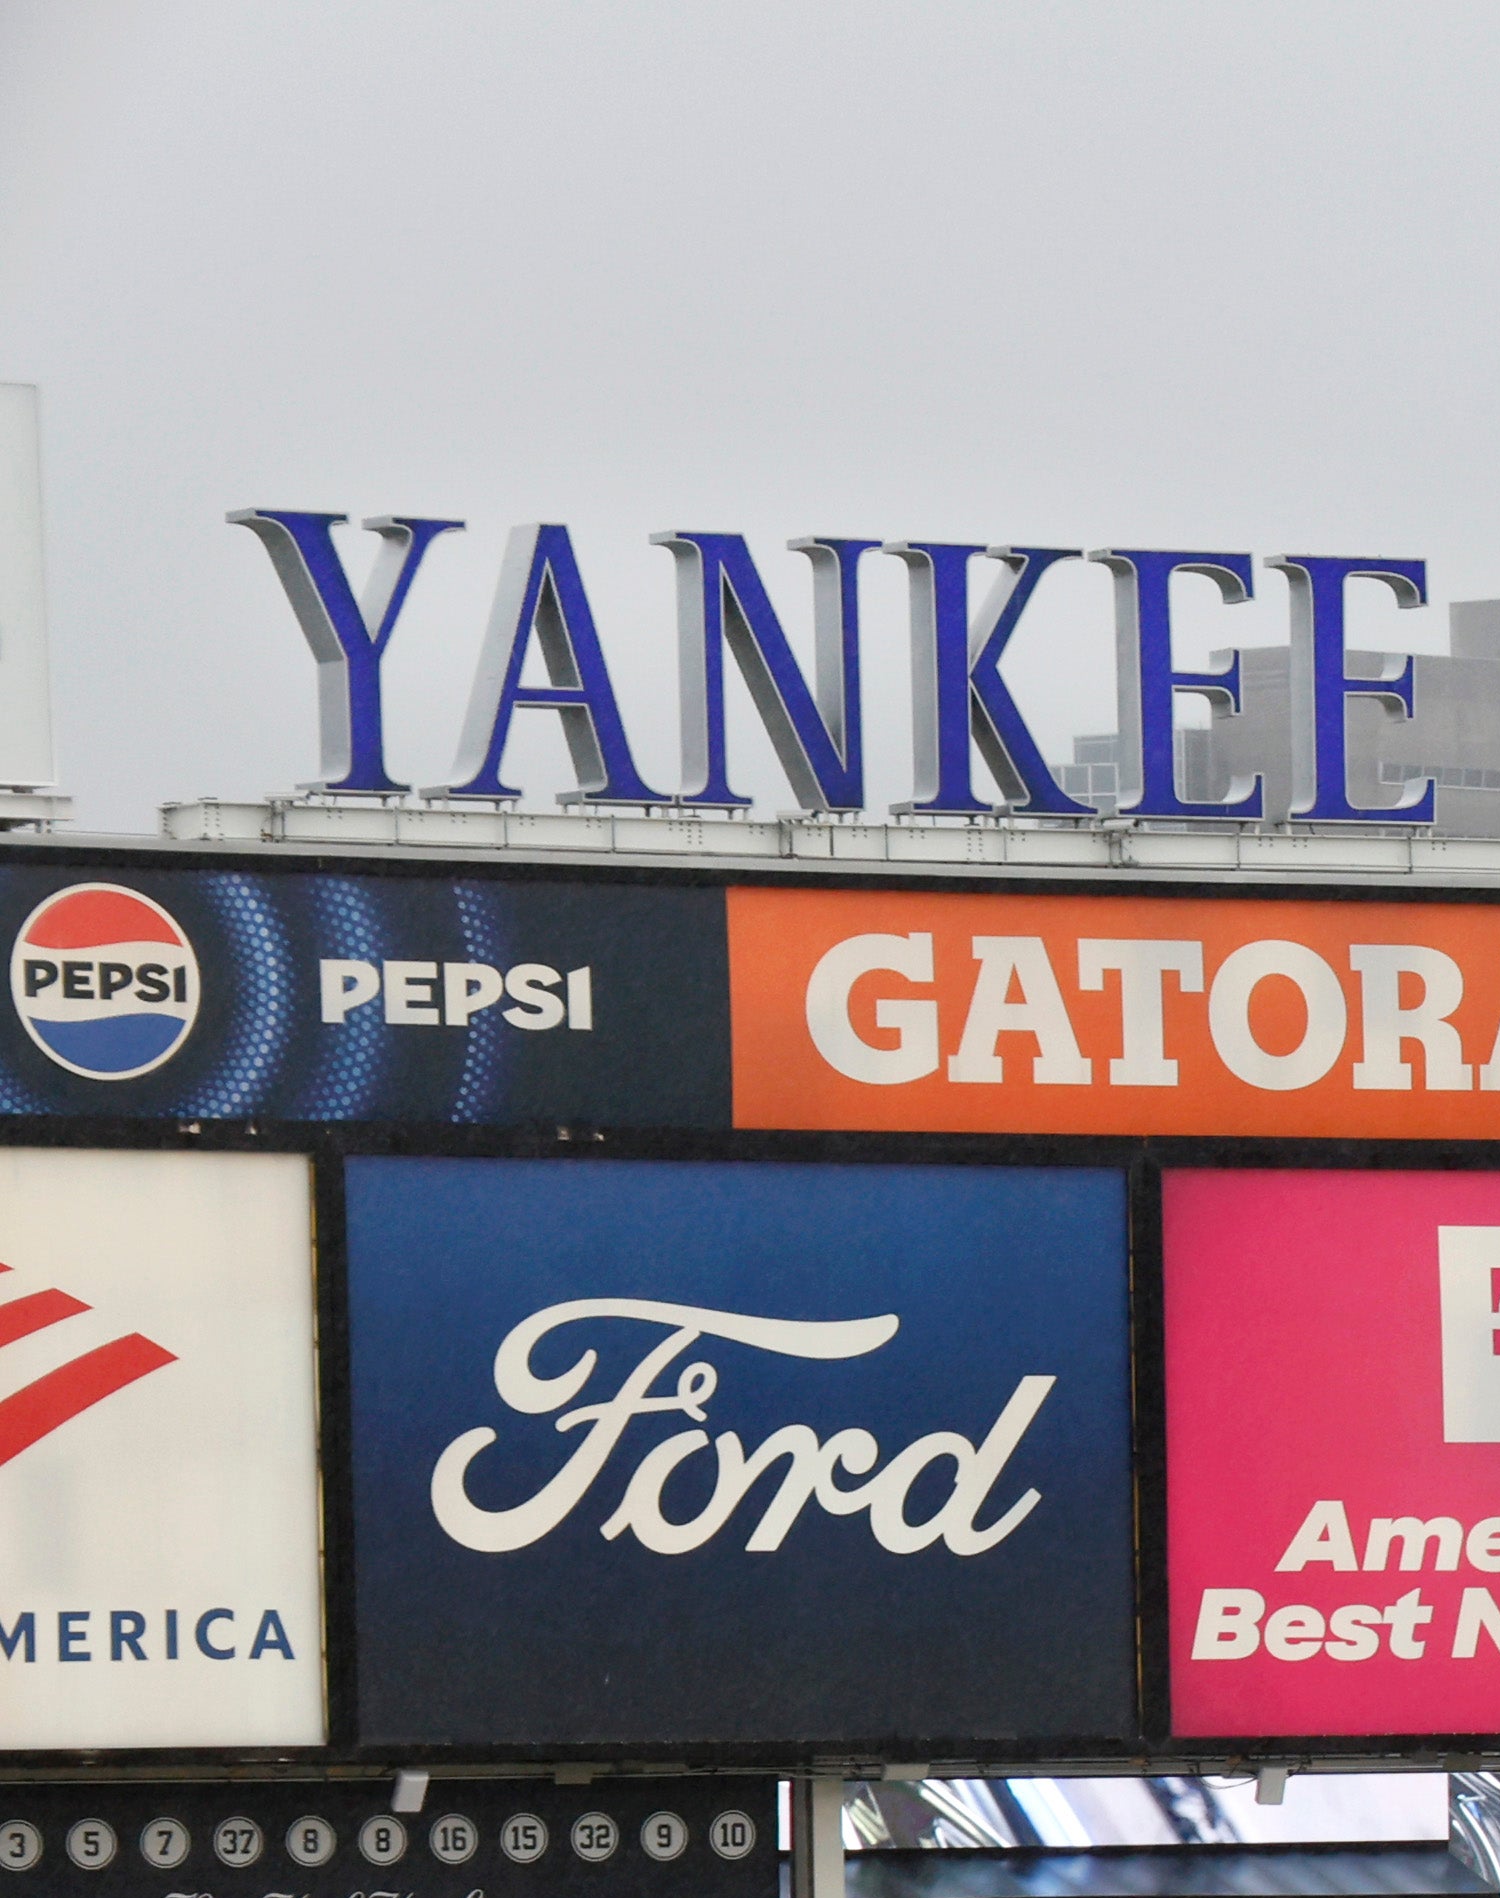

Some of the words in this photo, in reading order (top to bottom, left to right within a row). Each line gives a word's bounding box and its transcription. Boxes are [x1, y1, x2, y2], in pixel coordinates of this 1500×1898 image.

[226, 507, 1437, 826] YANKEE
[20, 956, 188, 1006] PEPSI
[320, 957, 593, 1031] PEPSI
[430, 1297, 1057, 1557] Ford
[1191, 1586, 1433, 1663] Best
[9, 1832, 26, 1857] 3
[84, 1831, 99, 1856] 5
[157, 1830, 173, 1855] 7
[222, 1829, 254, 1854] 37
[302, 1828, 319, 1853] 8
[375, 1827, 390, 1853] 8
[440, 1826, 466, 1851] 16
[511, 1825, 537, 1850] 15
[579, 1824, 610, 1849] 32
[656, 1823, 672, 1848] 9
[720, 1822, 745, 1848] 10
